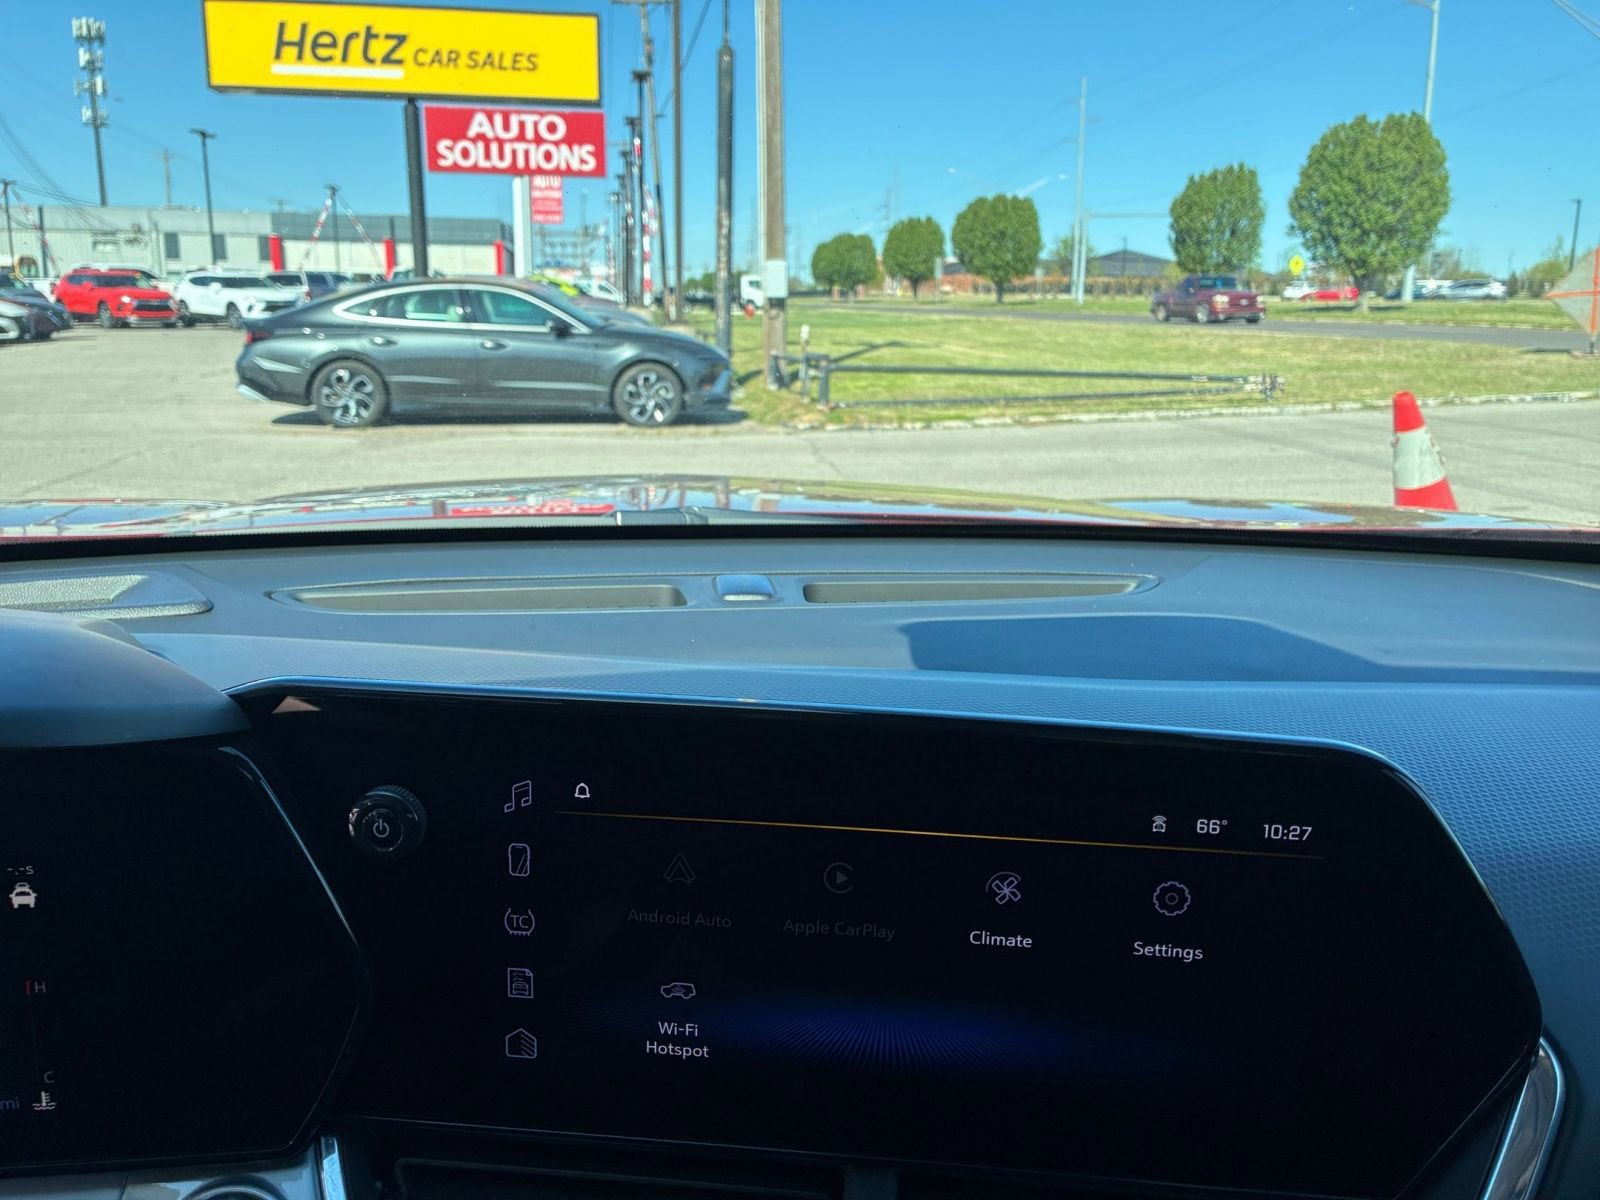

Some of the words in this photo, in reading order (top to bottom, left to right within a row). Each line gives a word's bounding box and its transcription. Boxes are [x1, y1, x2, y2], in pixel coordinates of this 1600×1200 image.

[274, 21, 408, 66] Hertz
[413, 47, 460, 69] CAR
[466, 50, 539, 72] SALES
[466, 111, 567, 142] AUTO
[436, 138, 598, 172] SOLUTIONS
[1196, 818, 1228, 835] 66°
[1263, 823, 1313, 842] 10:27
[509, 914, 530, 929] TC
[628, 908, 690, 926] Android
[695, 911, 732, 928] Auto
[783, 918, 830, 938] Apple
[834, 921, 895, 943] CarPlay
[969, 930, 1033, 948] Climate
[1133, 941, 1204, 962] Settings
[34, 981, 46, 994] H
[657, 1020, 699, 1038] Wi-Fi
[645, 1040, 709, 1060] Hotspot
[43, 1070, 56, 1084] C
